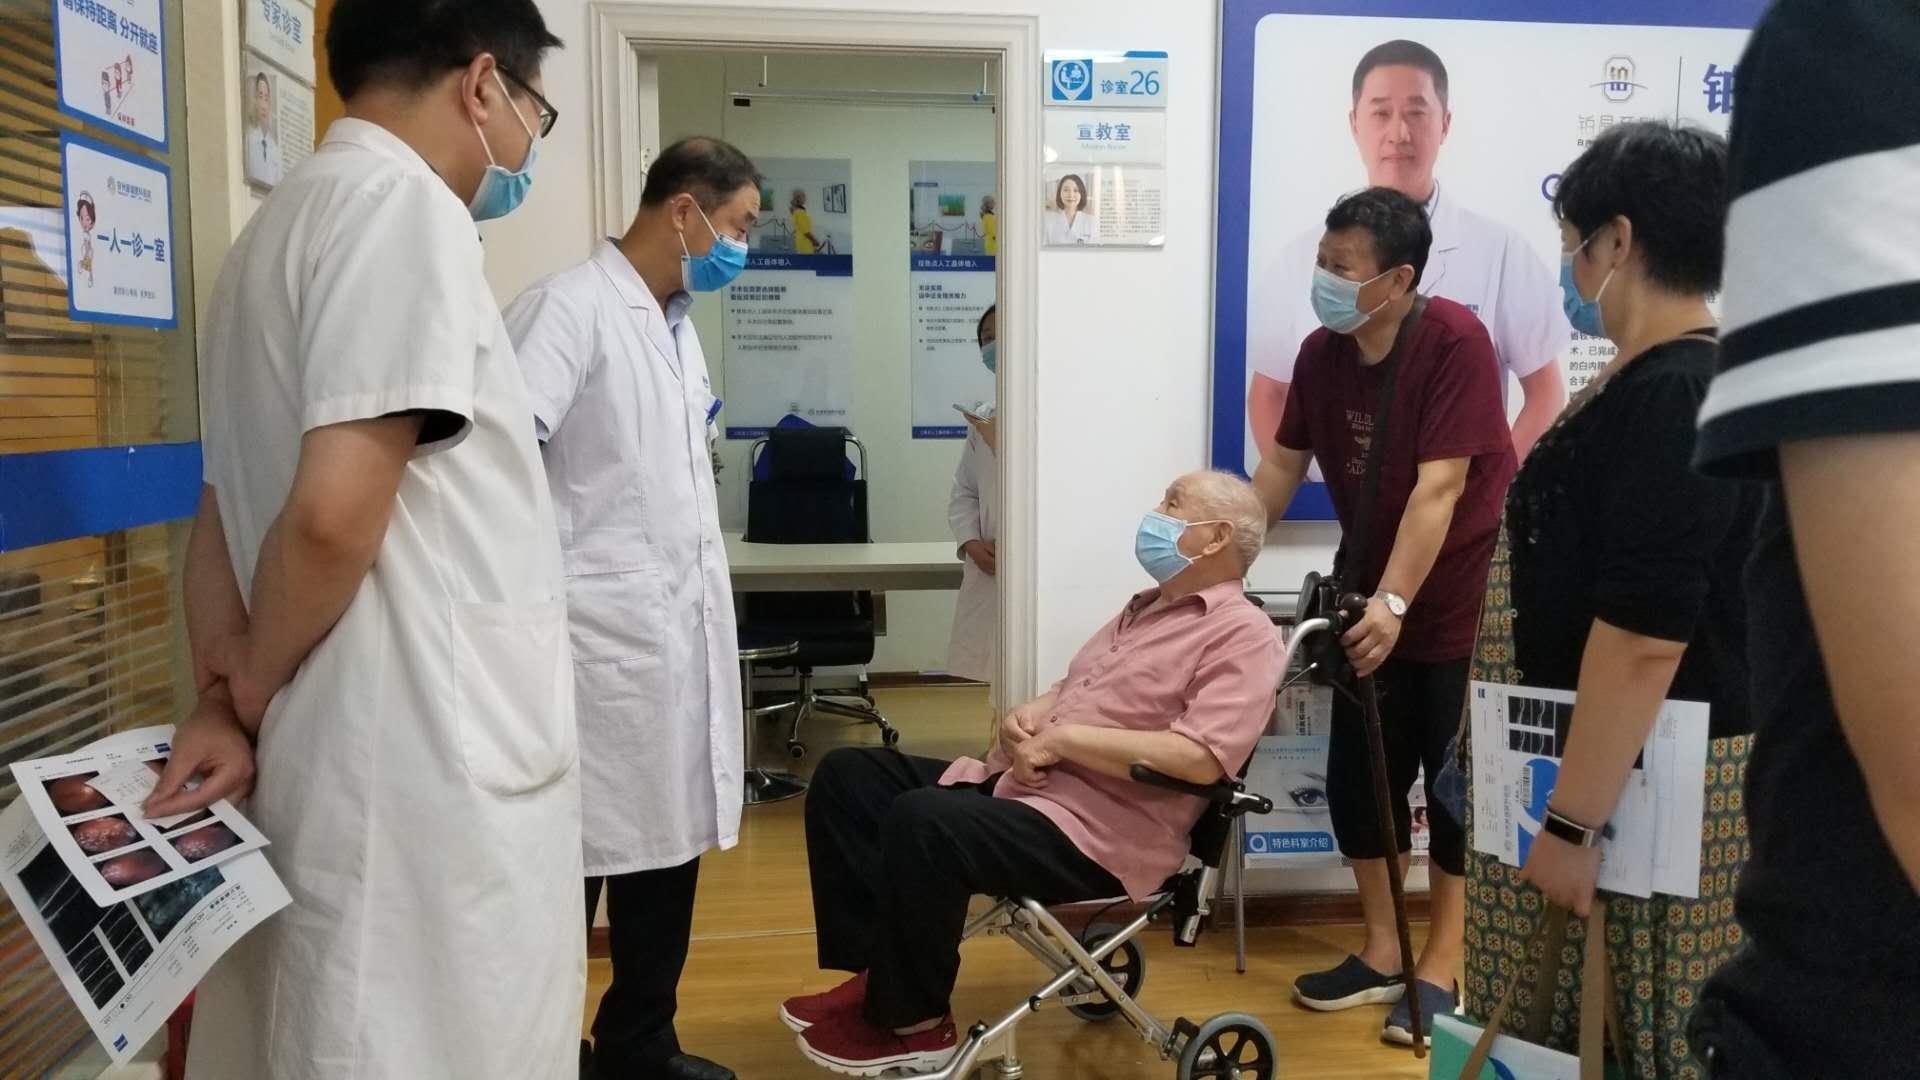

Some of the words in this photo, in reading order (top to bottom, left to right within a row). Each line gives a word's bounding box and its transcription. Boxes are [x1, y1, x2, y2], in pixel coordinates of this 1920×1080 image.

[1100, 70, 1160, 96] 诊室26
[1077, 122, 1131, 141] 宣教室
[97, 228, 165, 262] 一人一诊一室
[1272, 837, 1329, 849] 特色科室介绍
